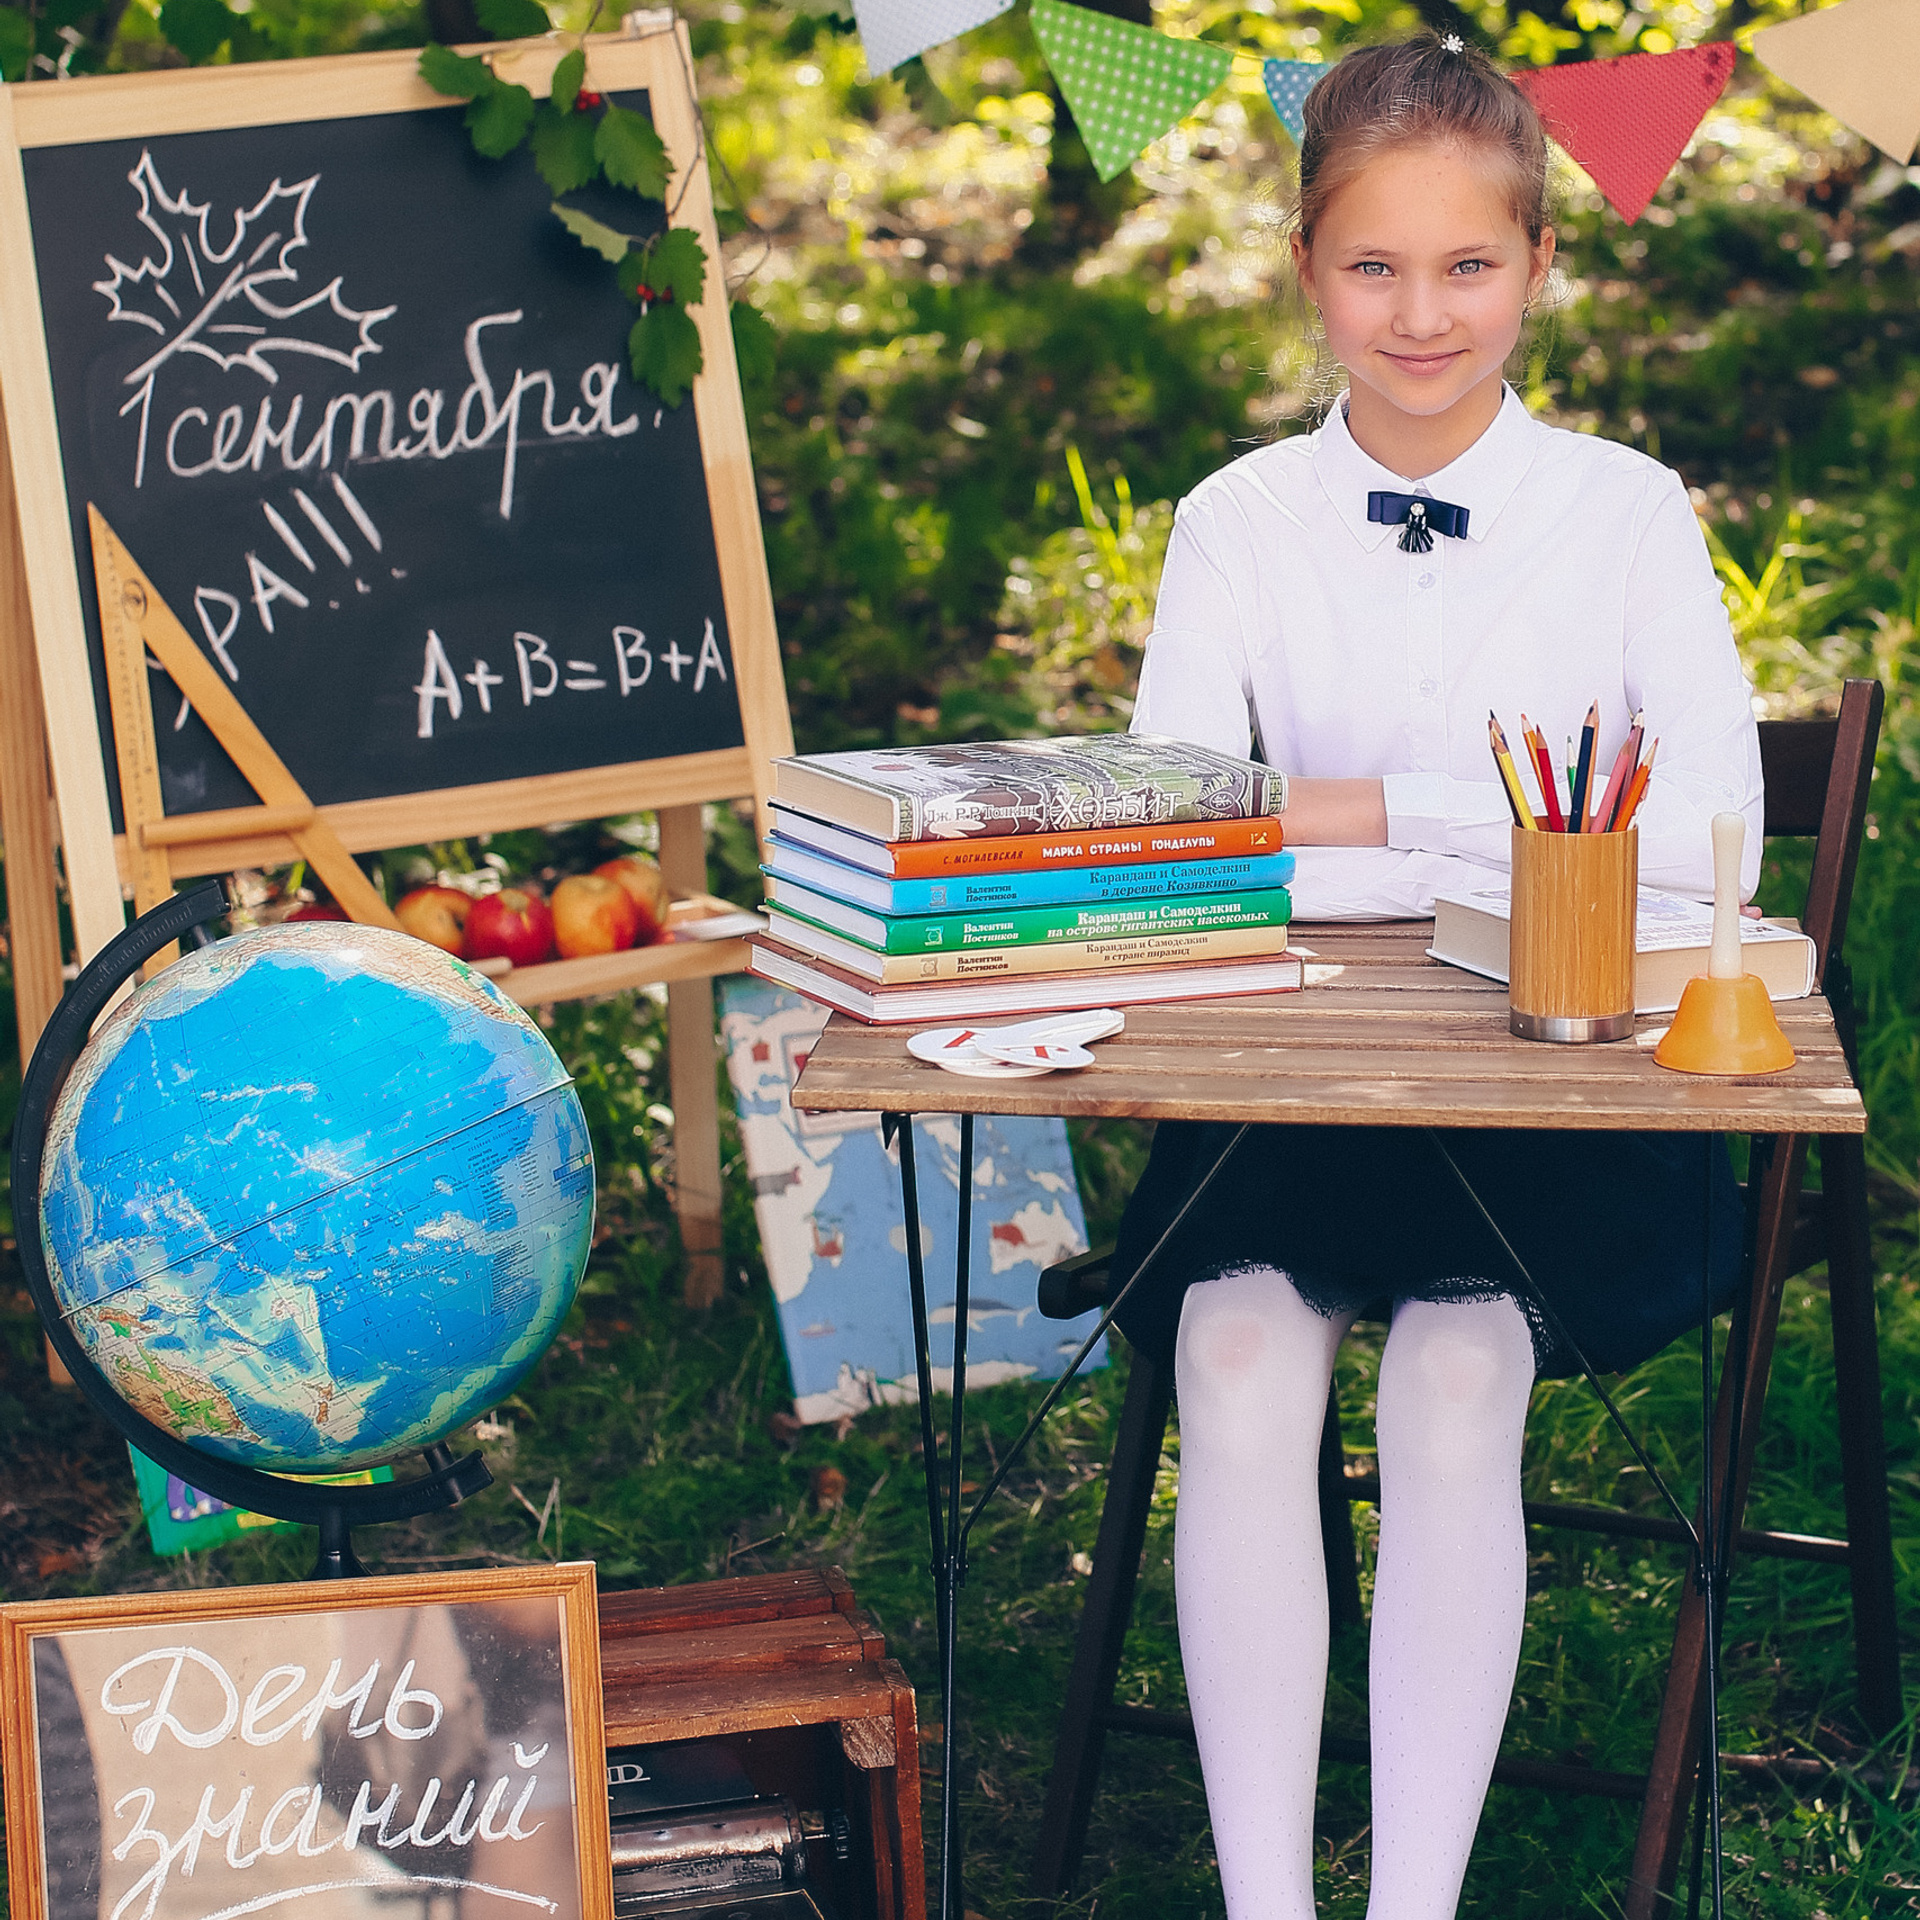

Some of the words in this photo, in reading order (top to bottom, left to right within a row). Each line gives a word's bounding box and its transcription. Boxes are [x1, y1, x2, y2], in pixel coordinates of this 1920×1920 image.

[119, 372, 156, 488] 1
[166, 300, 664, 520] сентября
[145, 470, 408, 735] РА!!!
[1052, 791, 1183, 825] ХОББИТ
[954, 850, 1024, 864] МОГИЛЕВСКАЯ
[1042, 844, 1083, 858] МАРКА
[1089, 841, 1142, 856] СТРАНЫ
[1151, 836, 1216, 851] ГОНДЕЛУПЫ
[1089, 869, 1157, 885] Карандаш
[1159, 869, 1168, 879] и
[1170, 862, 1251, 879] Самоделкин
[965, 884, 1012, 895] Валентин
[965, 892, 1018, 903] Постников
[1101, 887, 1109, 897] в
[1111, 882, 1164, 898] деревне
[1165, 877, 1238, 893] Козявкино
[1047, 927, 1063, 938] на
[1066, 923, 1118, 938] острове
[1120, 916, 1195, 933] гигантских
[1197, 911, 1270, 926] насекомых
[1077, 910, 1146, 926] Карандаш
[1149, 910, 1158, 919] и
[1160, 903, 1242, 918] Самоделкин
[962, 932, 1019, 944] Постников
[963, 921, 1014, 934] Валентин
[1086, 942, 1137, 955] Карандаш
[1139, 940, 1146, 949] и
[1147, 935, 1209, 950] Самоделкин
[1112, 950, 1145, 963] стране
[1147, 947, 1191, 960] пирамид
[957, 955, 1003, 966] Валентин
[957, 962, 1009, 974] Постников
[101, 1645, 444, 1755] День
[111, 1741, 547, 1920] знаний
